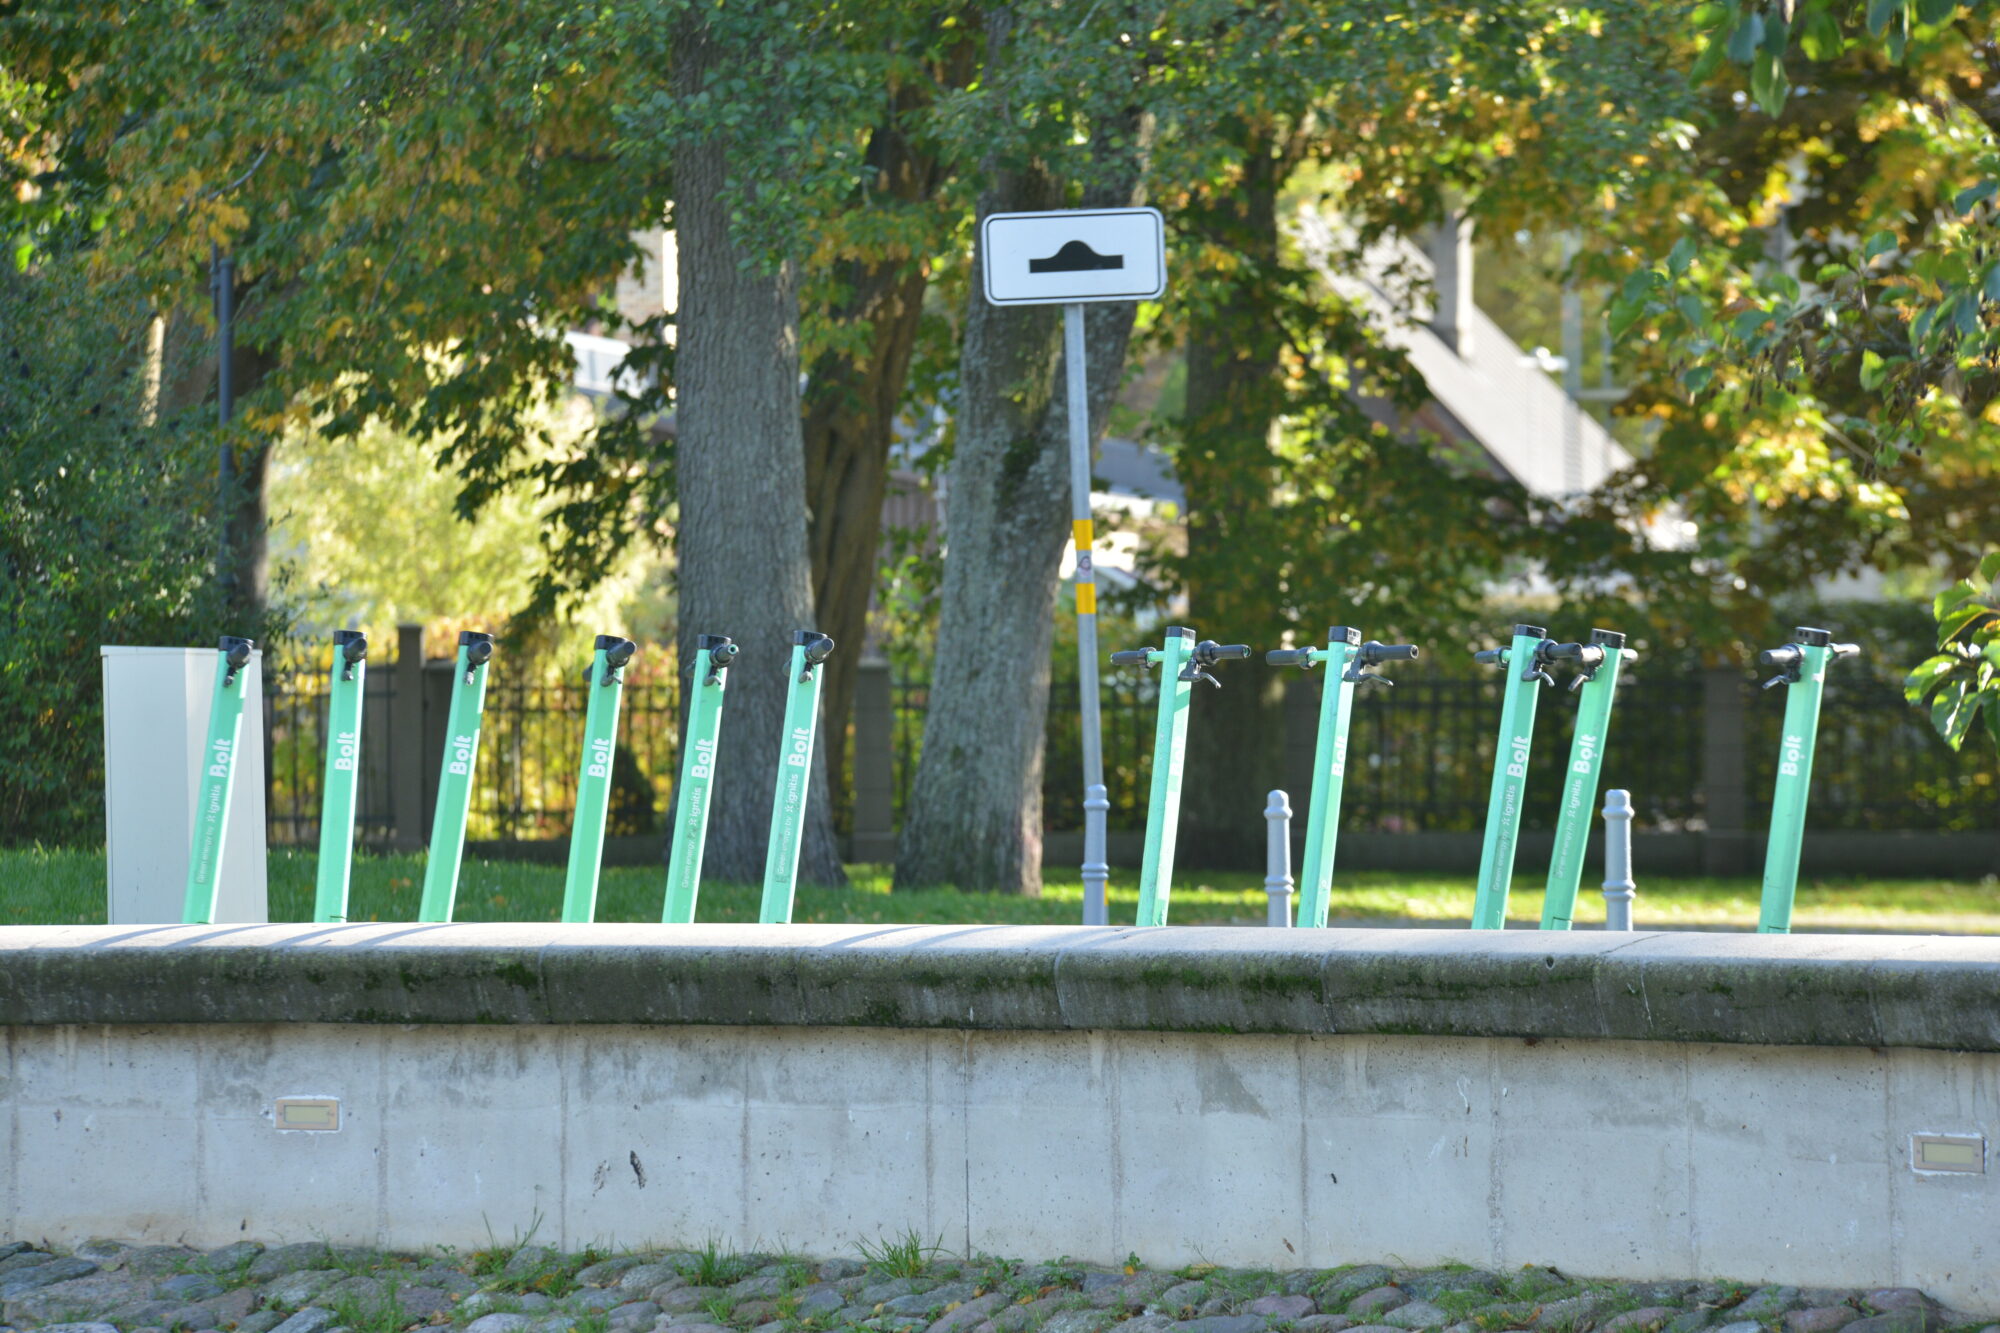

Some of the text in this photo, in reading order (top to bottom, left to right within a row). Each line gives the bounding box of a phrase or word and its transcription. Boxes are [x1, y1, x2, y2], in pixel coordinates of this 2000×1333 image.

[209, 738, 231, 778] Bolt
[334, 732, 354, 770] Bolt
[448, 736, 471, 775] Bolt
[588, 738, 610, 778] Bolt
[691, 738, 713, 778] Bolt
[788, 728, 810, 767] Bolt
[1331, 736, 1347, 776] Bolt
[1506, 736, 1529, 778] Bolt
[1573, 734, 1597, 774] Bolt
[1780, 735, 1802, 776] Bolt
[690, 787, 702, 816] ignitis
[787, 774, 799, 803] ignitis
[1503, 785, 1515, 816] ignitis
